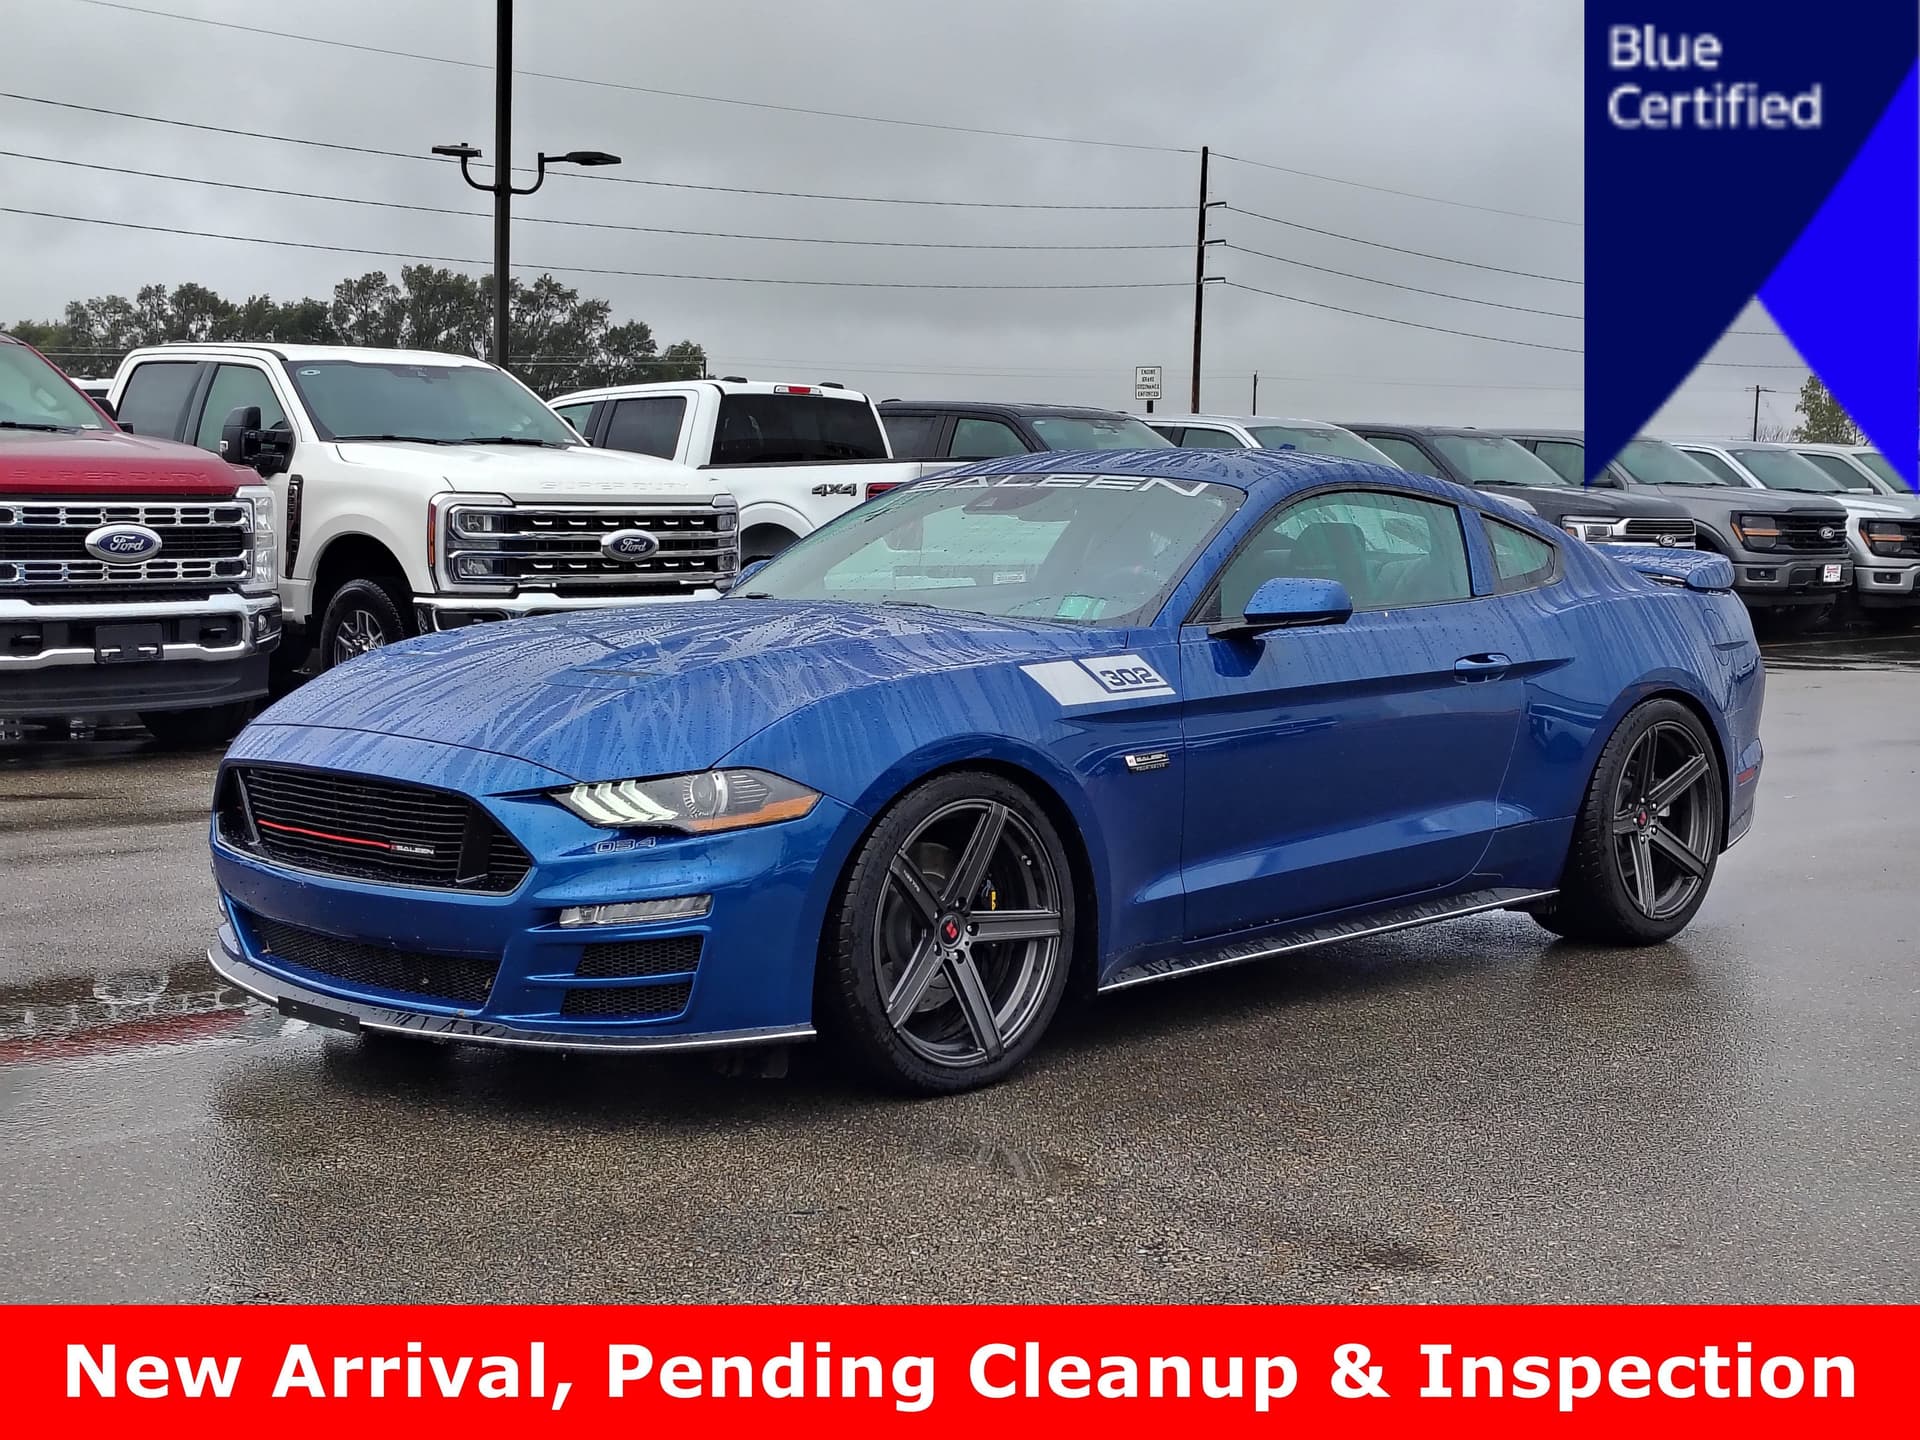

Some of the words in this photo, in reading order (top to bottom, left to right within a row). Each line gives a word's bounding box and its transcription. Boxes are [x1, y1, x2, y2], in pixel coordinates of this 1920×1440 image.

[904, 474, 1209, 497] SALEEN
[109, 535, 145, 552] Ford
[619, 537, 647, 552] Ford
[1099, 666, 1160, 686] 302
